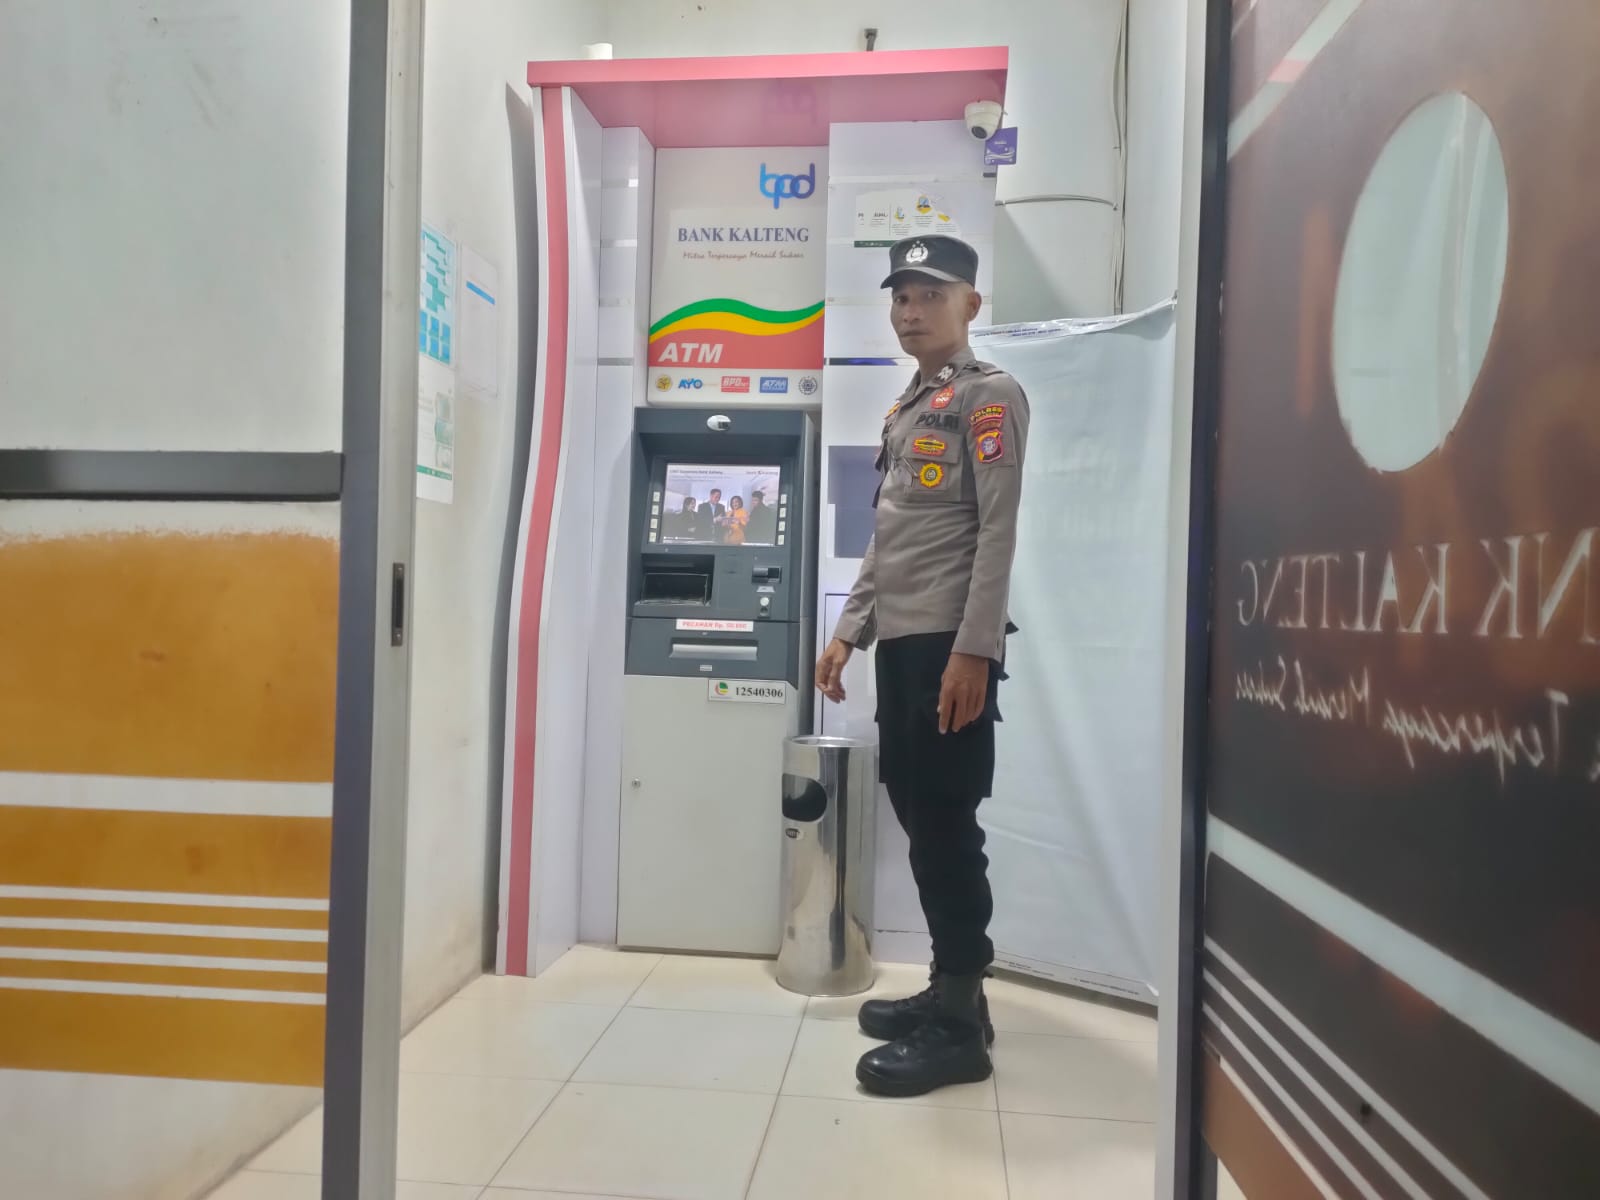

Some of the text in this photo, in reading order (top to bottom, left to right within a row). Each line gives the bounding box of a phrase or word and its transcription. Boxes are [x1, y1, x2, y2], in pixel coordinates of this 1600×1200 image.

[677, 227, 809, 243] BANK KALTENG
[658, 342, 723, 363] ATM
[915, 413, 960, 431] POLRI
[735, 686, 784, 698] 12540306
